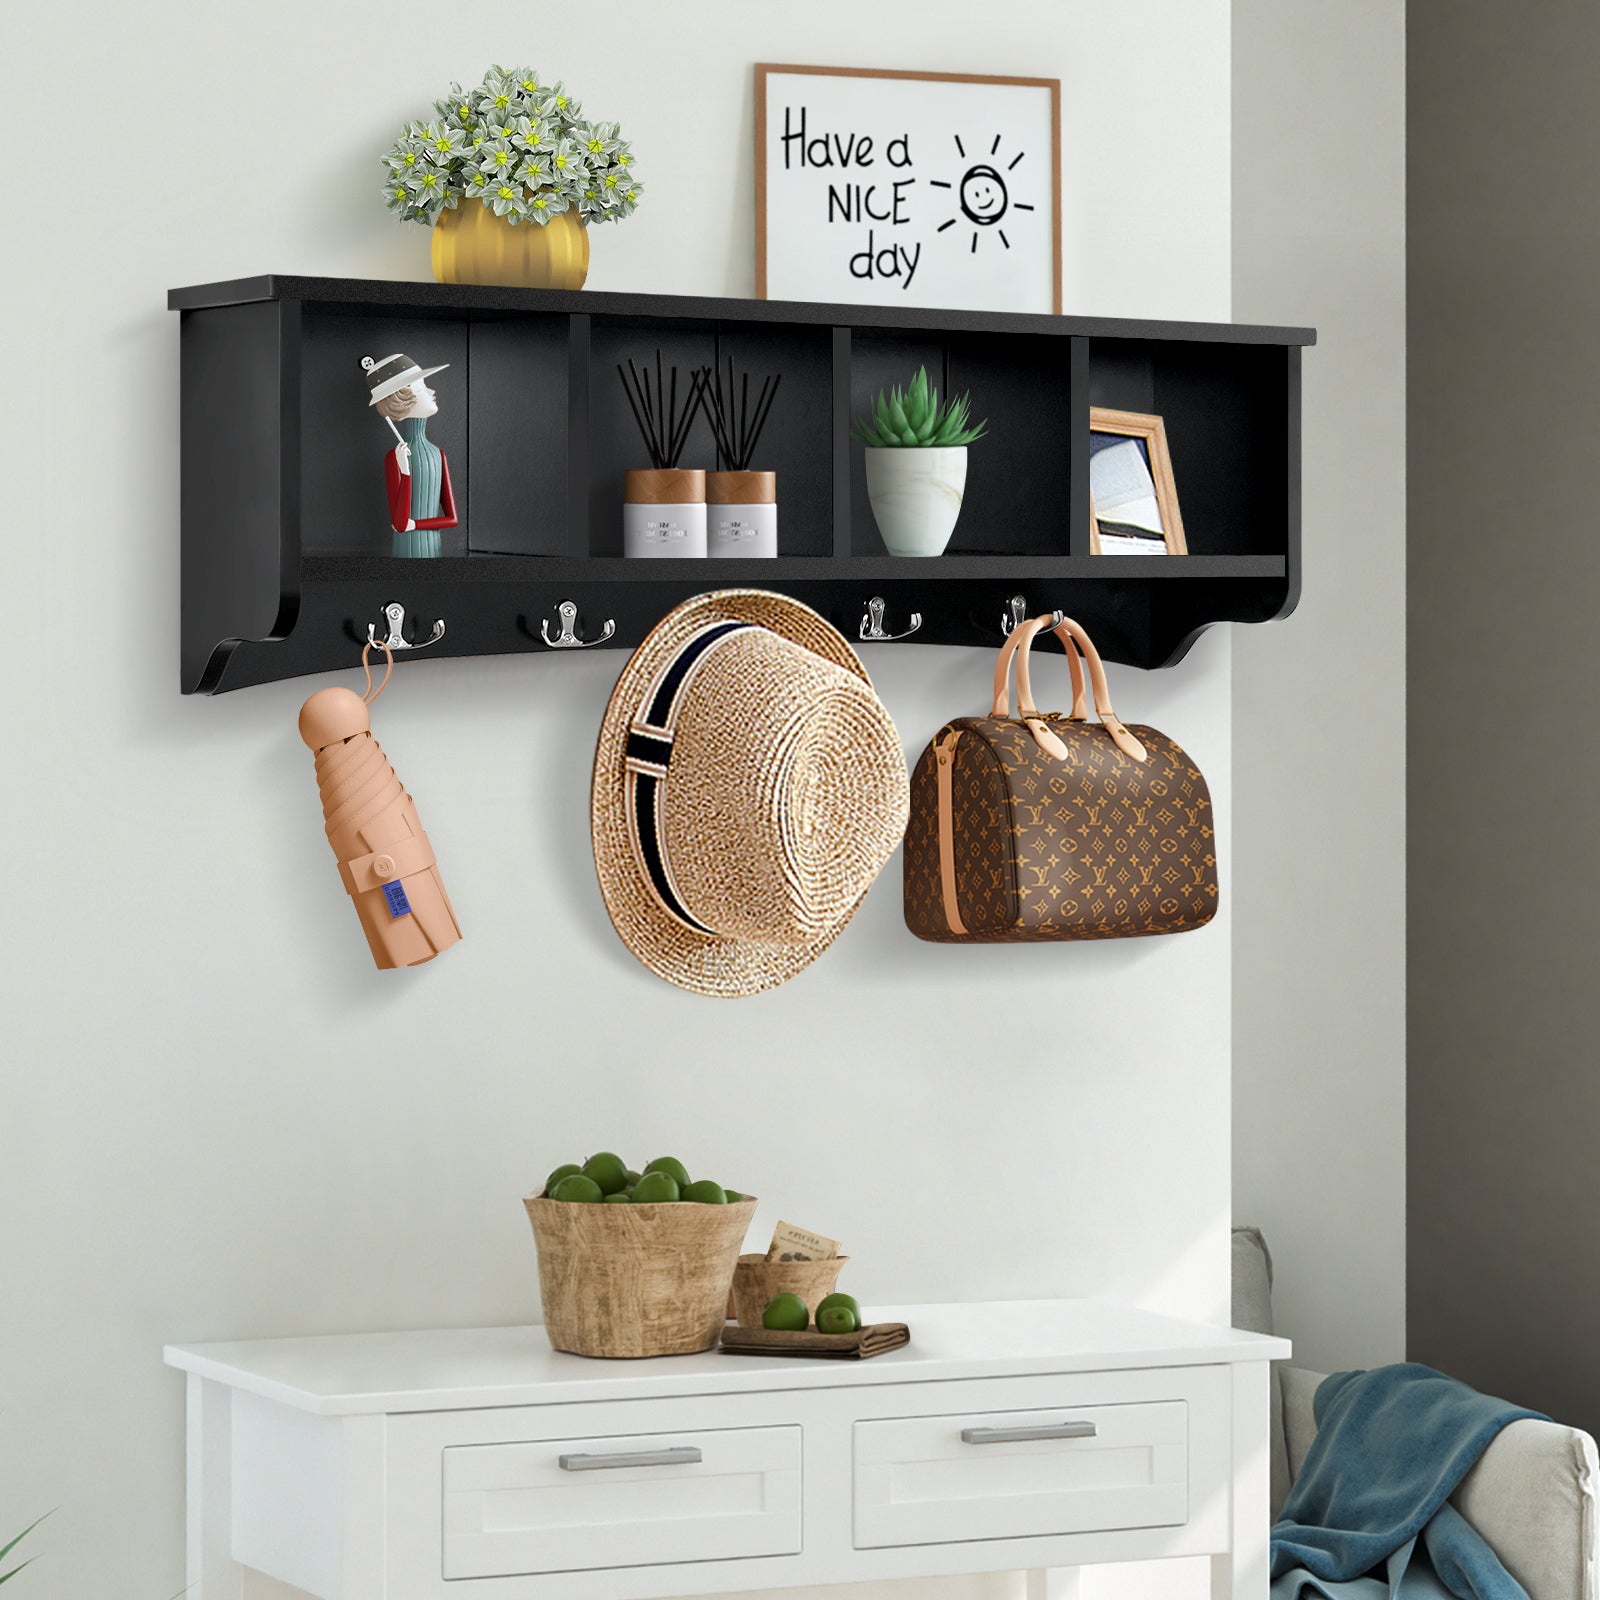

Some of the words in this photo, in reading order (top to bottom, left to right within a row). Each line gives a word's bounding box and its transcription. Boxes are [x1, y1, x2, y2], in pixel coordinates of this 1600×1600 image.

[781, 107, 873, 169] Have
[887, 134, 912, 167] a
[829, 179, 915, 225] NICE
[850, 230, 920, 289] day
[1024, 805, 1045, 825] LV
[1085, 806, 1101, 826] LV
[1132, 807, 1149, 826] LV
[1184, 808, 1200, 827] LV
[1029, 866, 1050, 887] LV
[1092, 866, 1108, 887] LV
[1139, 866, 1154, 886] LV
[1191, 866, 1206, 885] LV
